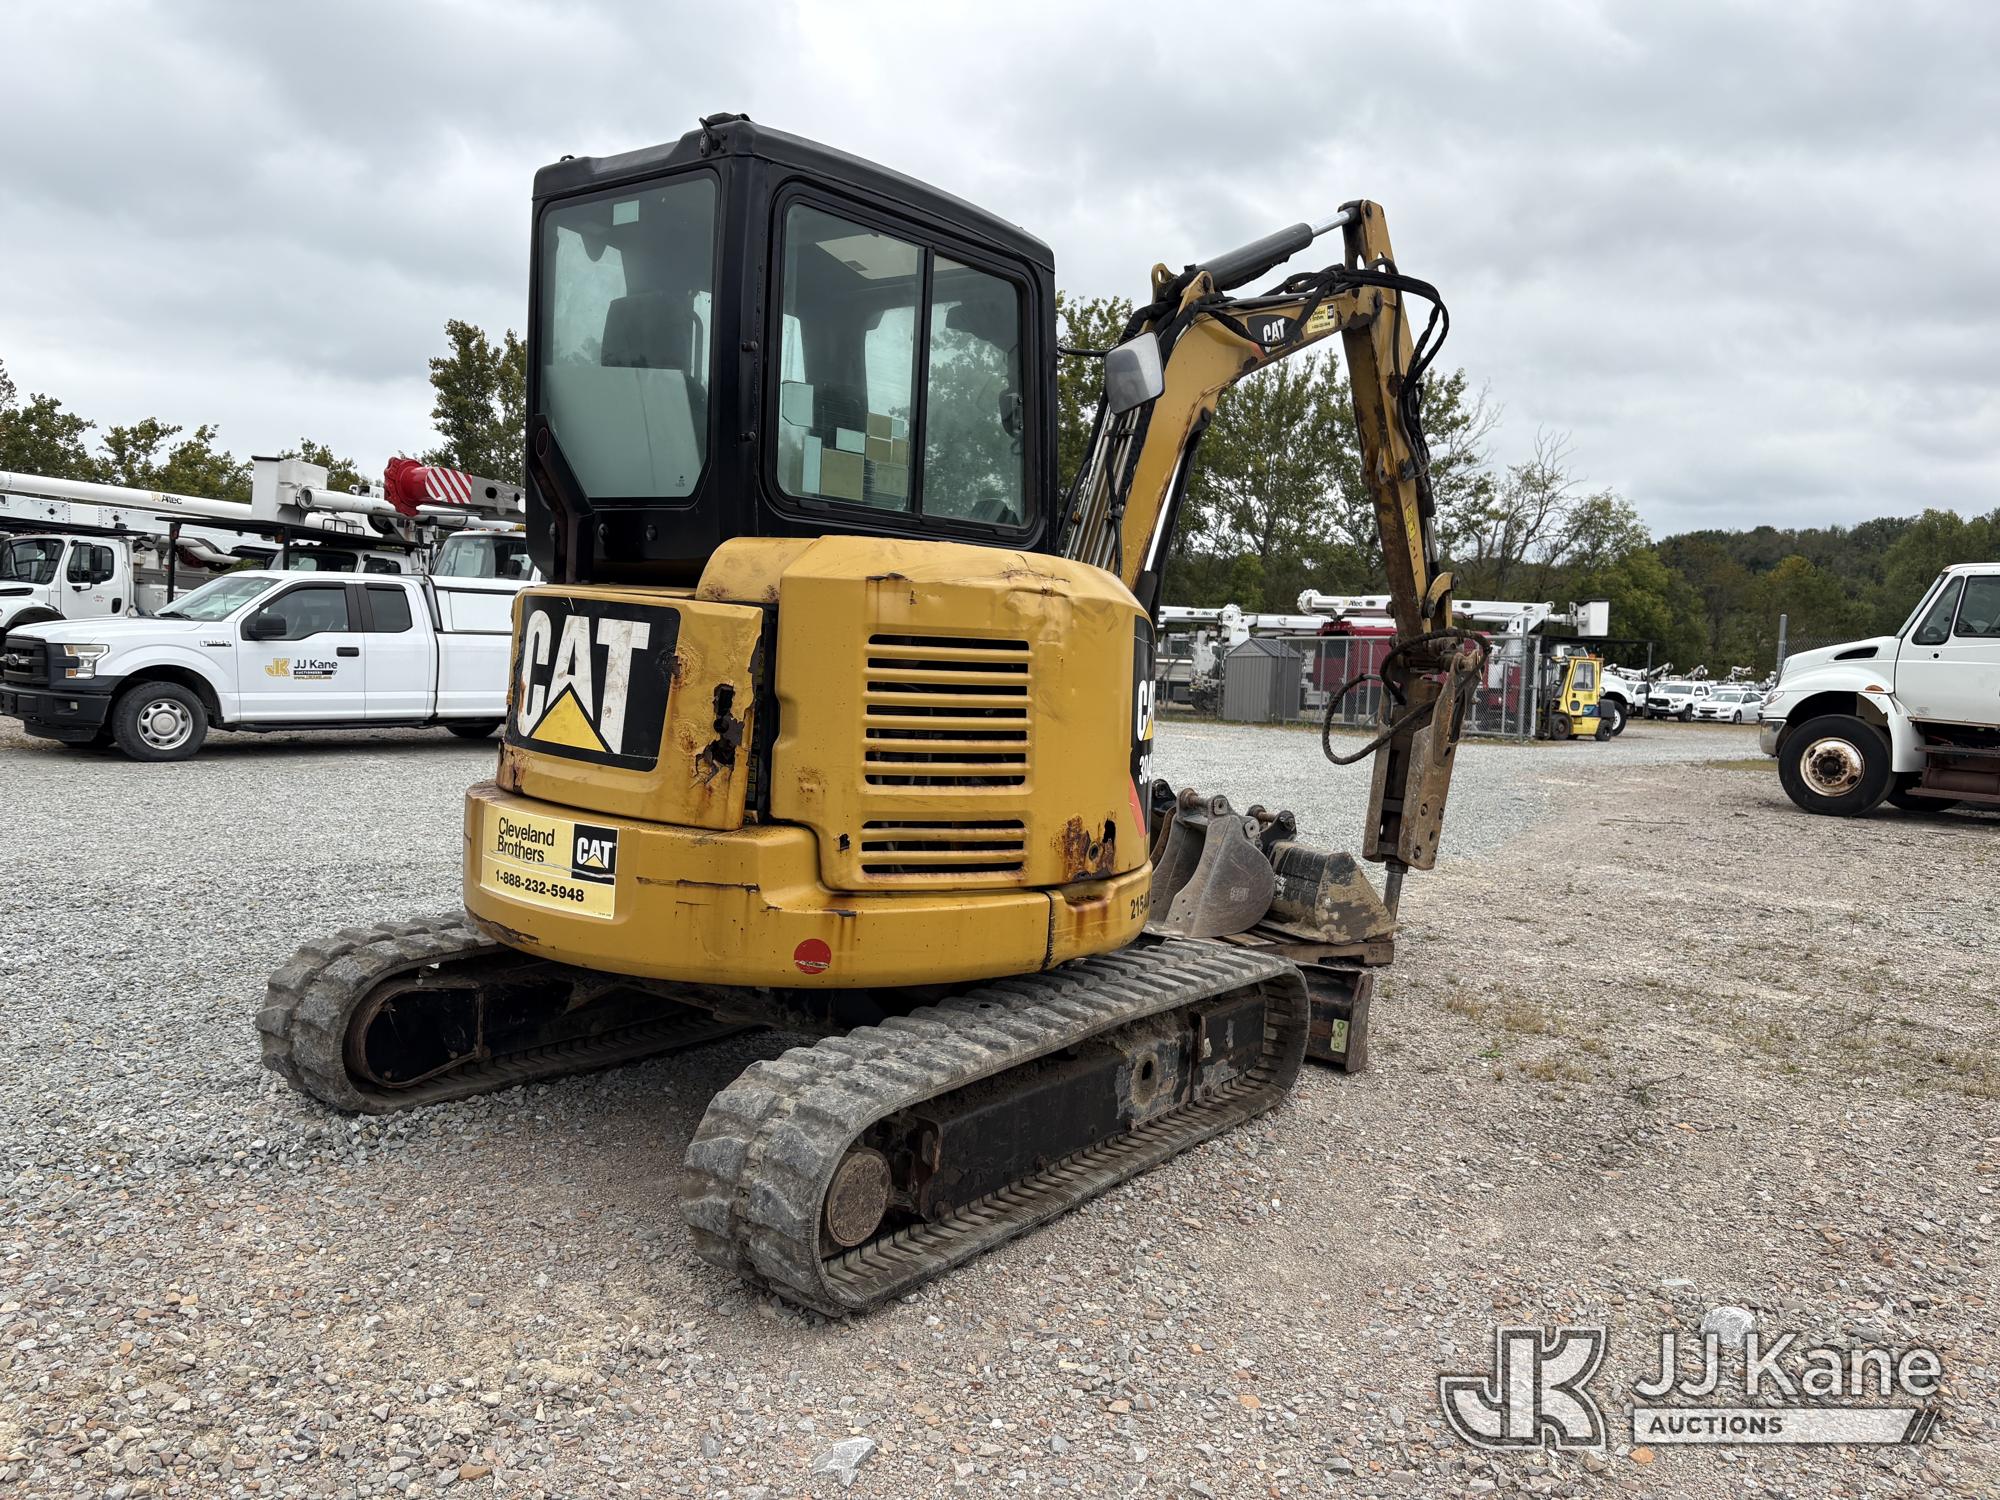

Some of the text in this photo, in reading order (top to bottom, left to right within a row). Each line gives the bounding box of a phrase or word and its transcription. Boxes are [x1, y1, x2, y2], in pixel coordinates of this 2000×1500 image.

[1262, 317, 1285, 353] CAT
[294, 659, 338, 669] JJ Kane
[517, 609, 651, 755] CAT
[1137, 680, 1155, 741] CA
[498, 816, 555, 847] Cleveland
[497, 835, 545, 863] Brothers
[576, 837, 613, 869] CAT
[495, 869, 585, 903] 1-888-232-5948
